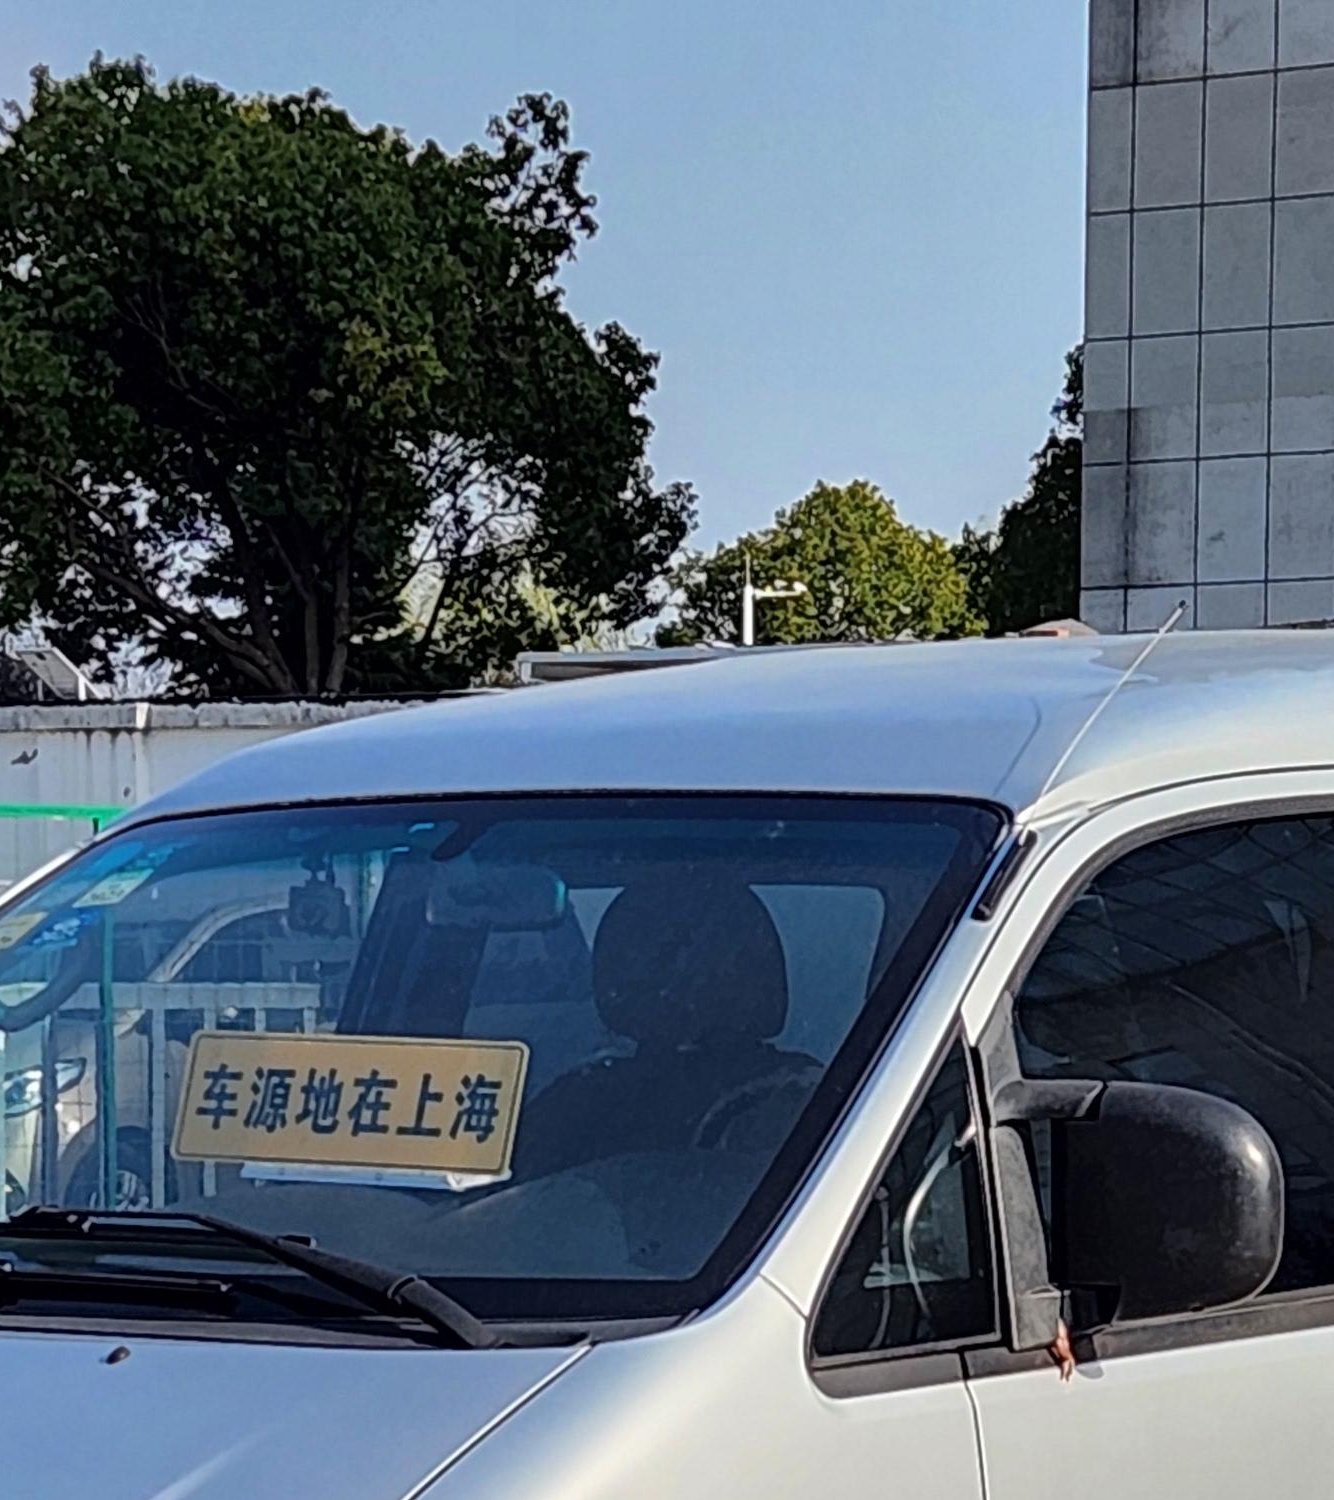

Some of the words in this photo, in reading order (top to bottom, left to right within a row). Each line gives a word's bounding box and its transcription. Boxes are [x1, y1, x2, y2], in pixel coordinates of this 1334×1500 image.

[195, 1063, 504, 1143] 车源地在上海
